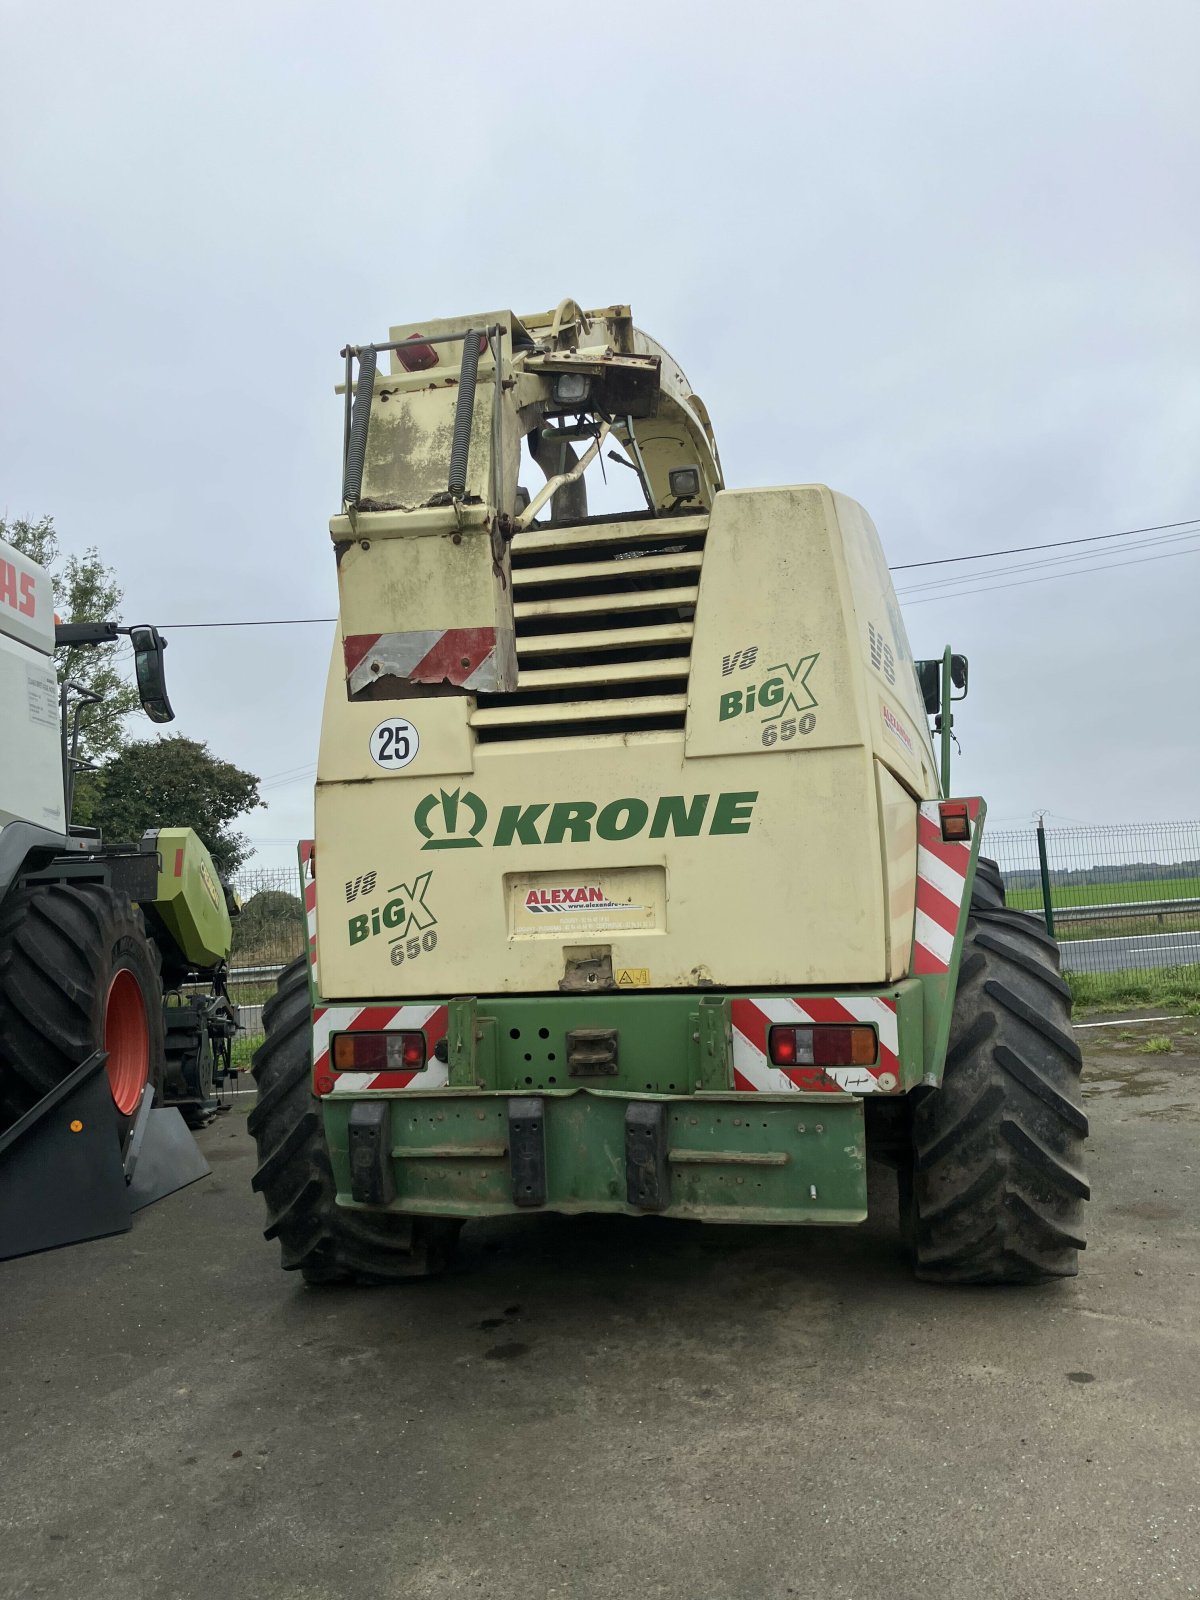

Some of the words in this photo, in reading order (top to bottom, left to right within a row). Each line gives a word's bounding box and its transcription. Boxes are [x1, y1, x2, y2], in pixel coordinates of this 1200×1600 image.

[722, 646, 759, 676] V8
[377, 726, 410, 761] 25
[761, 712, 817, 748] 650
[493, 790, 759, 848] KRONE
[345, 870, 377, 904] V8
[390, 929, 438, 967] 650
